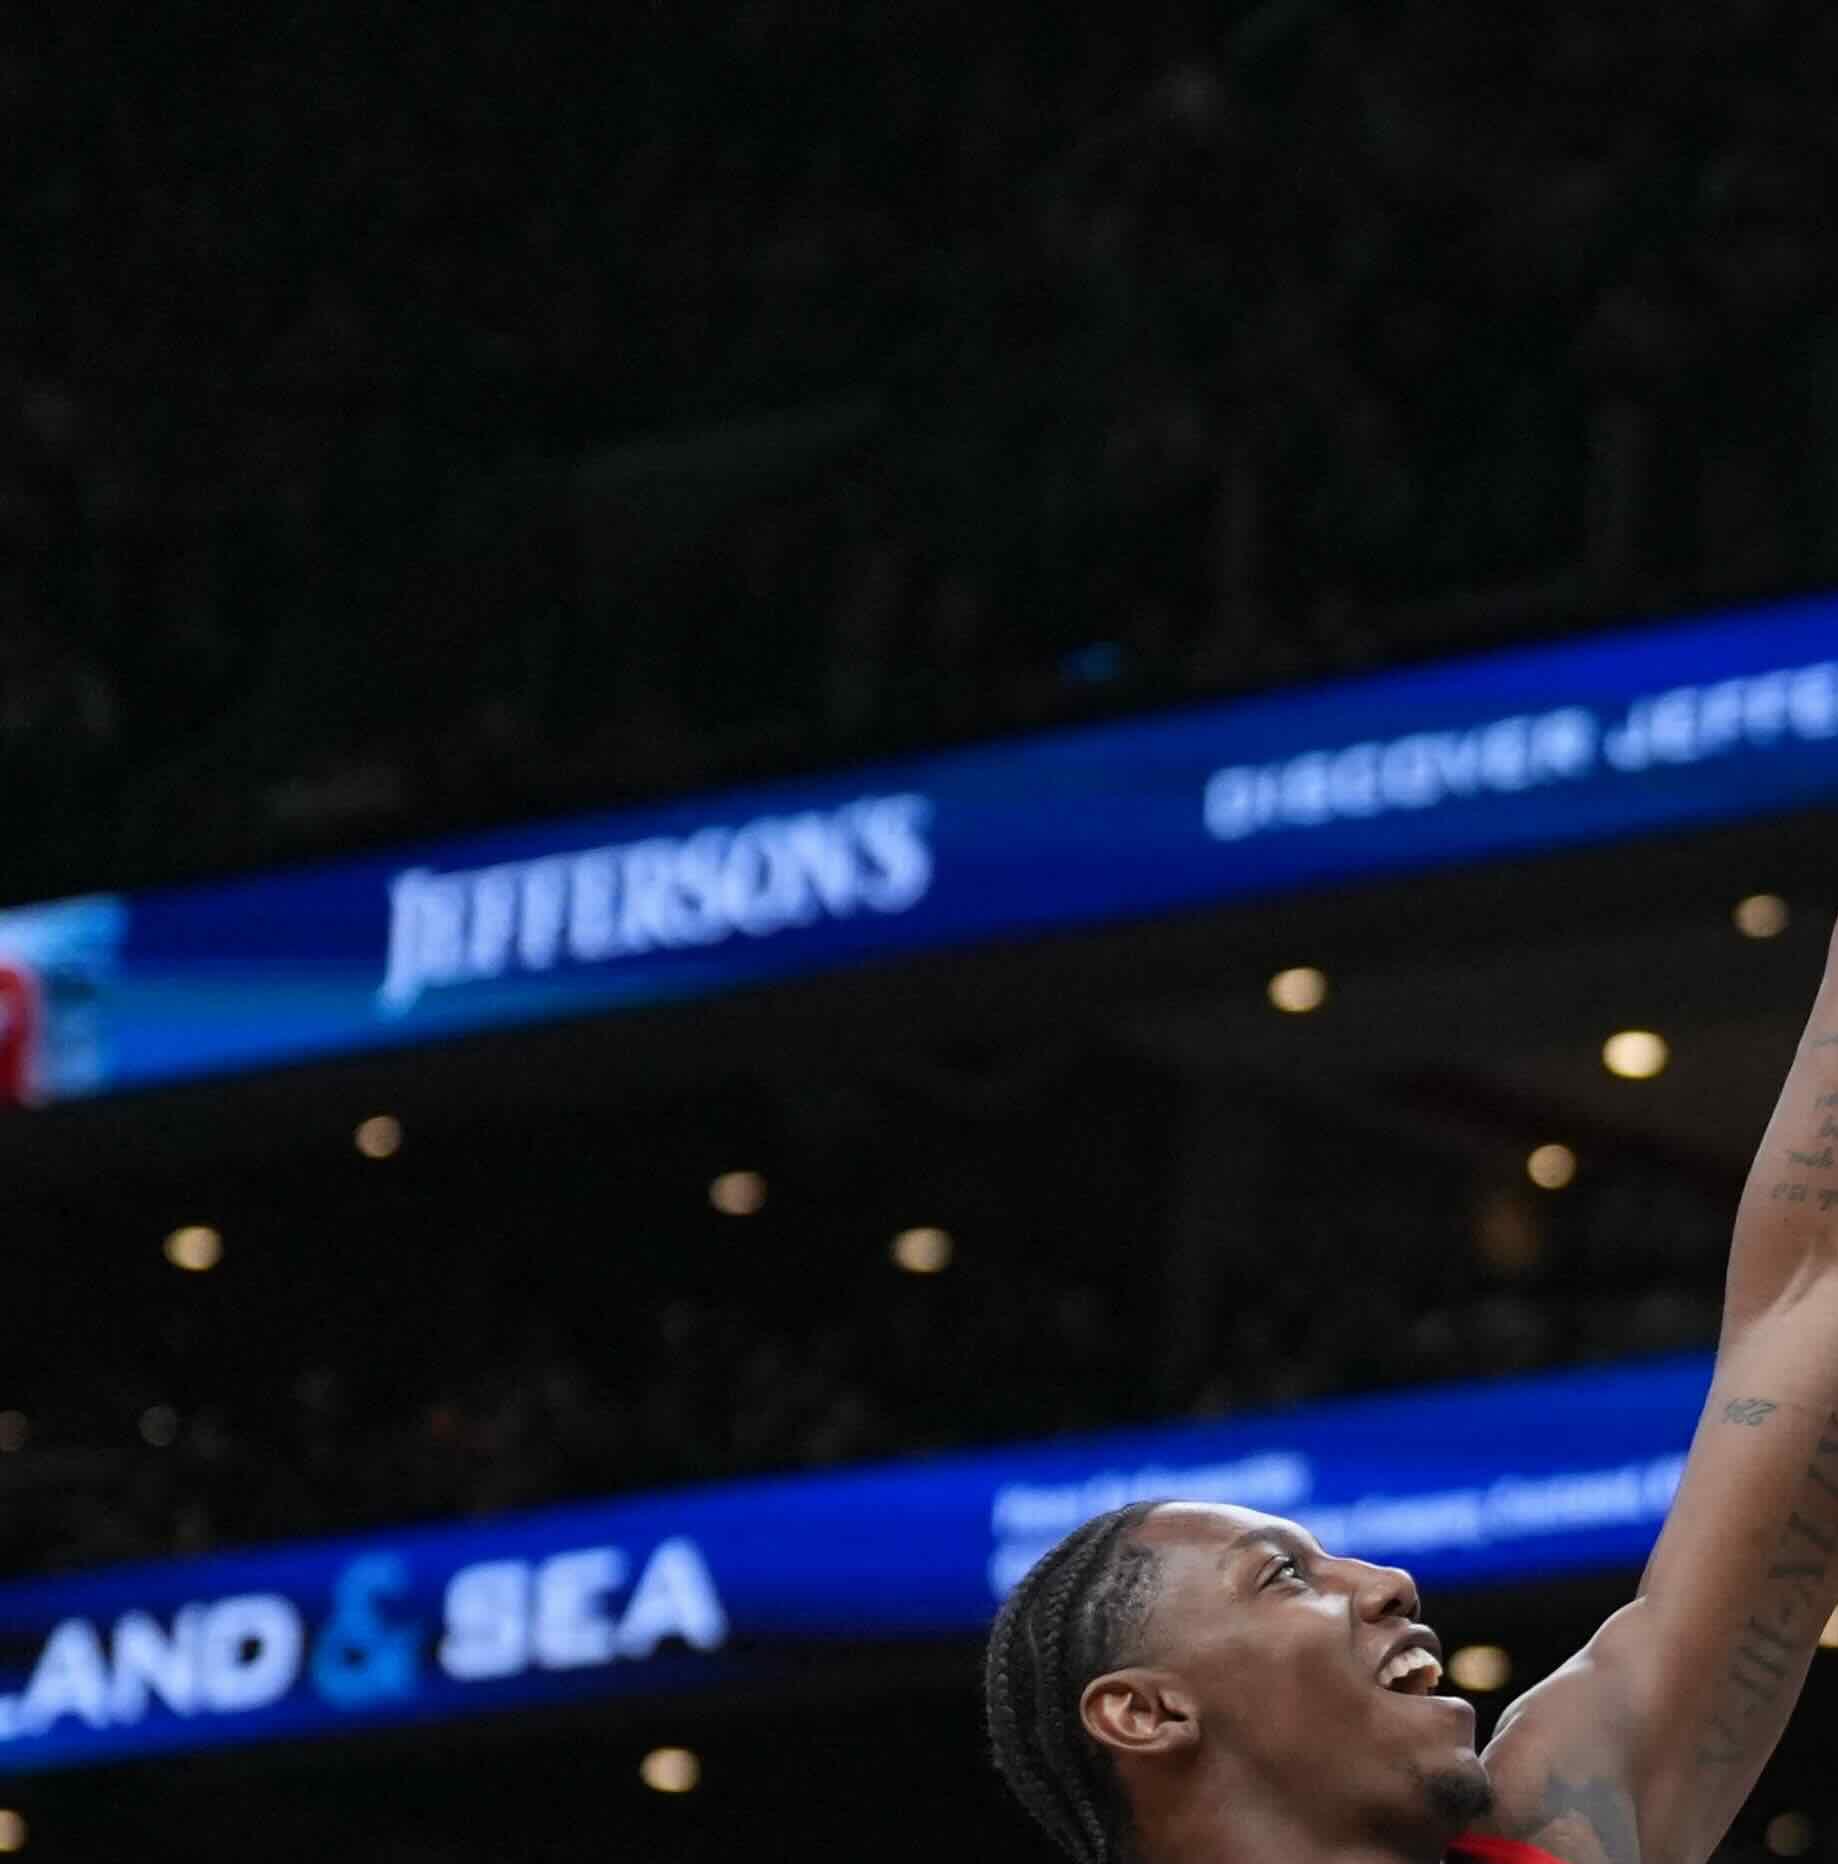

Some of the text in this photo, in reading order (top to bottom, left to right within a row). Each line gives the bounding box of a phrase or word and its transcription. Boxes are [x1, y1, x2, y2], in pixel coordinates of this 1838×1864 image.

[1204, 704, 1594, 841] DISCOVER
[312, 1548, 422, 1712] &
[437, 1536, 729, 1683] SEA
